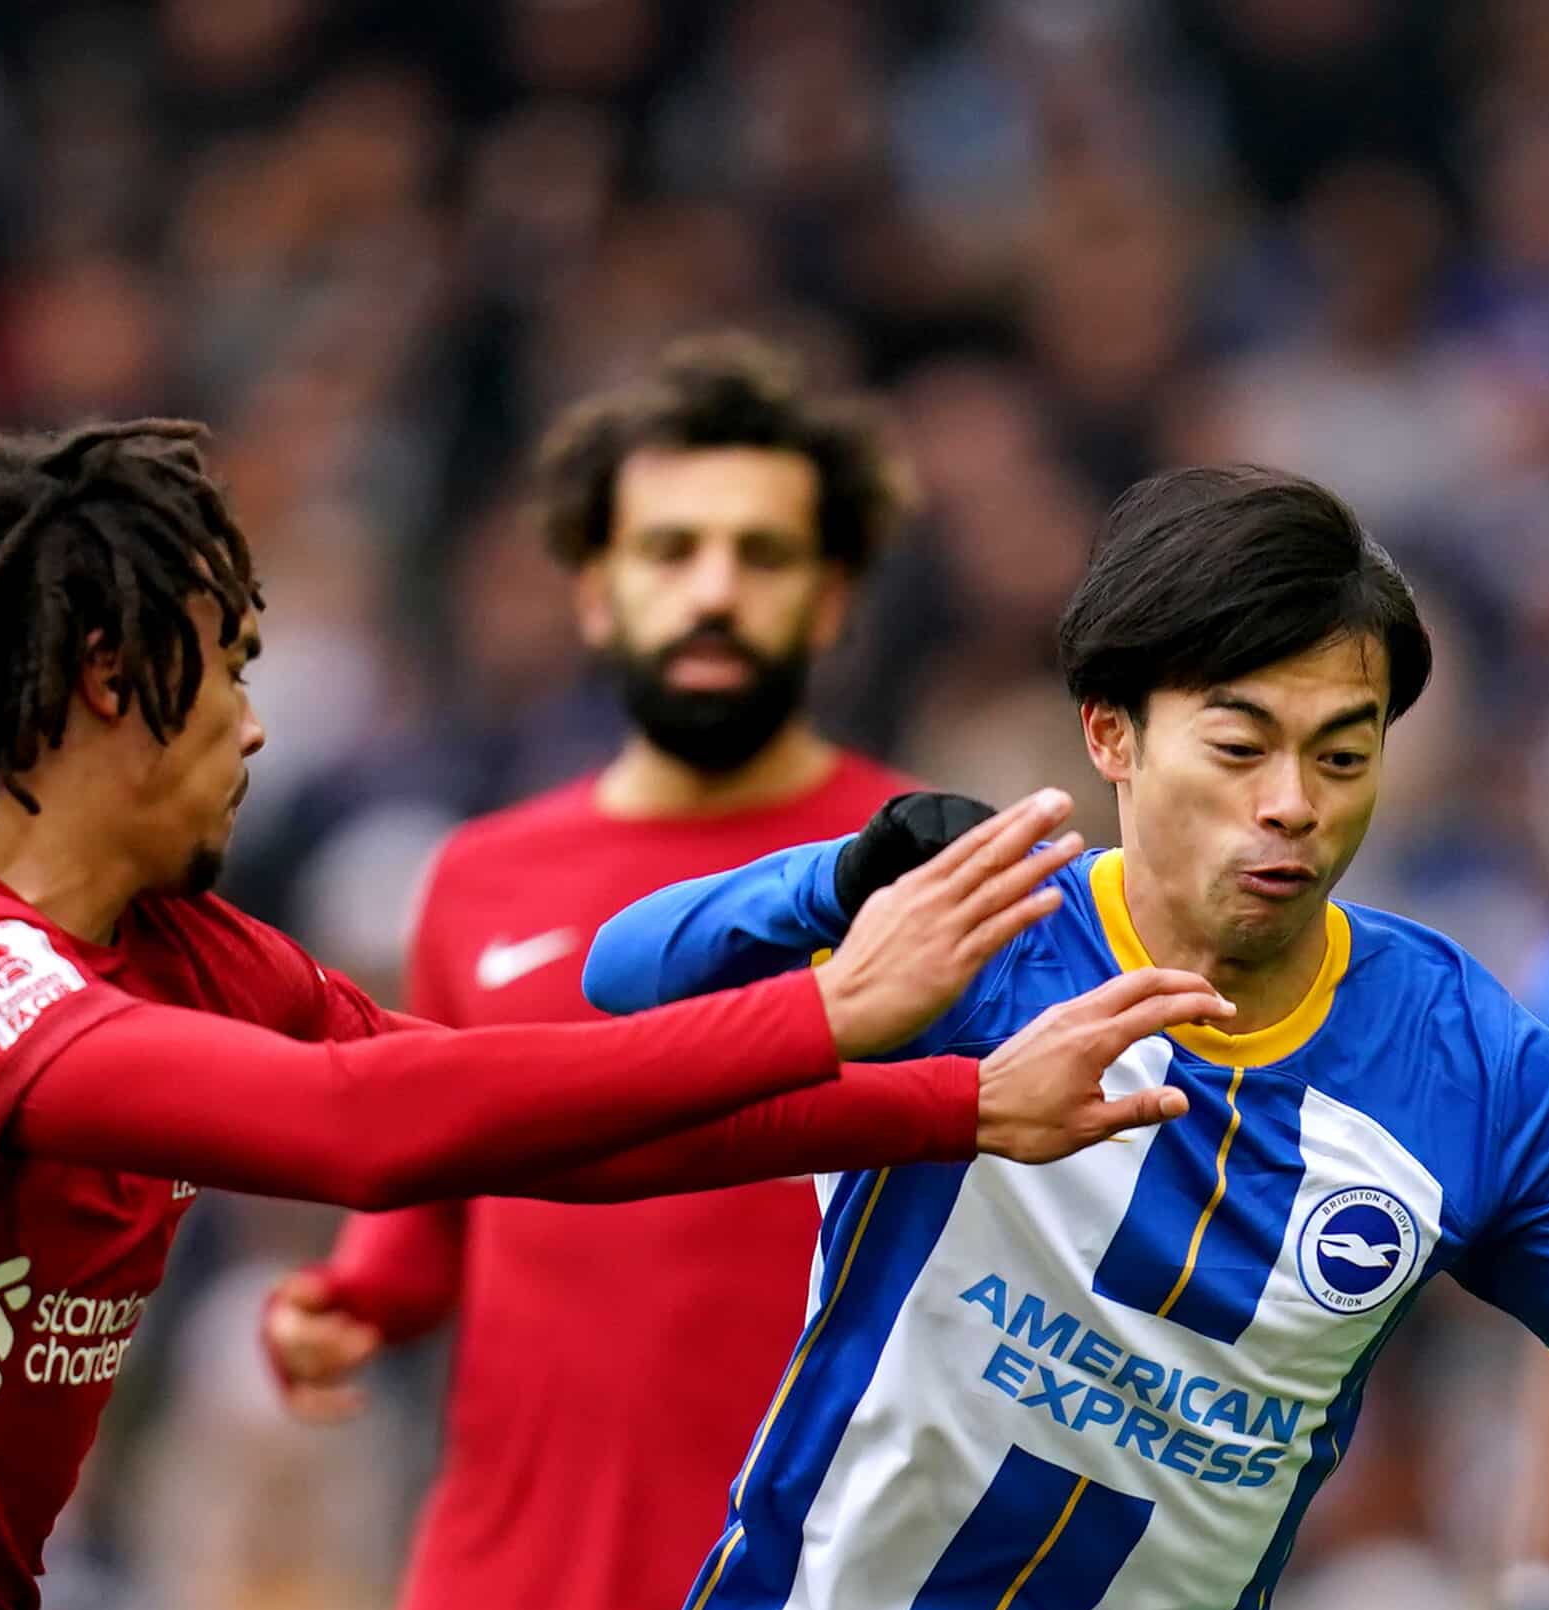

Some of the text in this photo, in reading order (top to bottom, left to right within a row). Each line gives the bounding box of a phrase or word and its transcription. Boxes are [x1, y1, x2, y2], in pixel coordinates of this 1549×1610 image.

[1321, 1191, 1413, 1235] BRIGHTON & HOVE
[1321, 1289, 1364, 1308] ALBION
[958, 1273, 1305, 1445] AMERICAN
[981, 1342, 1289, 1487] EXPRESS
